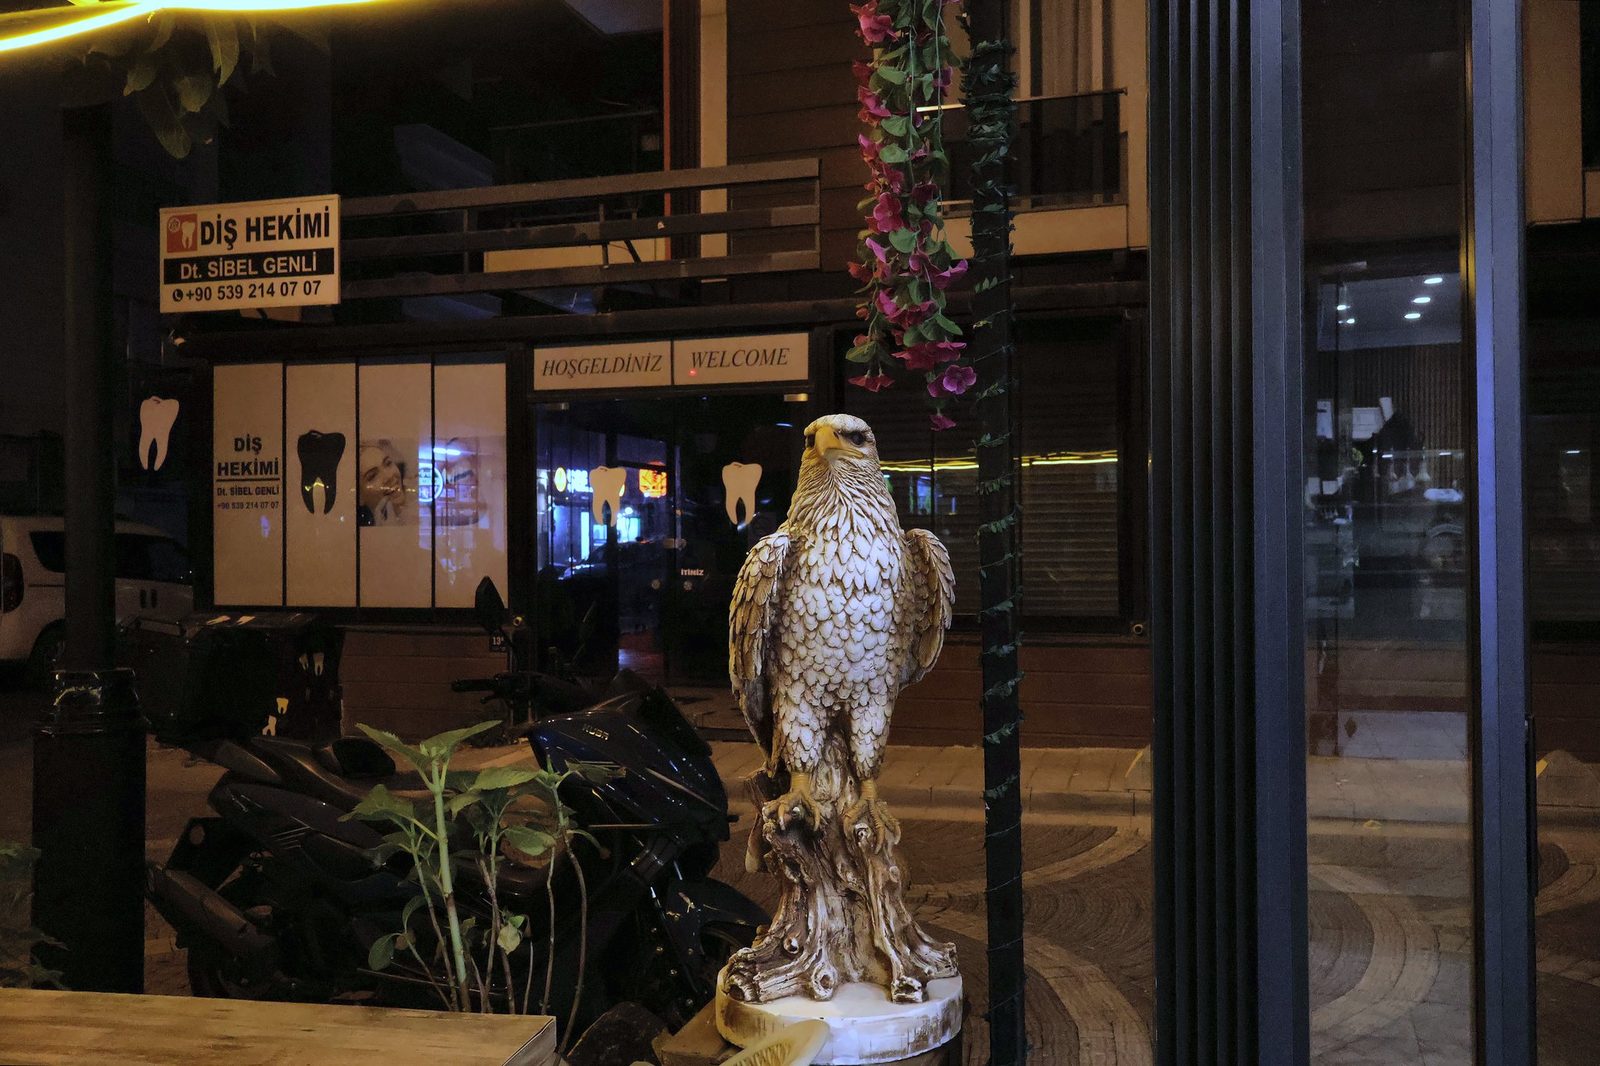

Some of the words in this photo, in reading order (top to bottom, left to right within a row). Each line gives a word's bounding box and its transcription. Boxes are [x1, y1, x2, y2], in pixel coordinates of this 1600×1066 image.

[200, 214, 237, 250] DİŞ
[245, 205, 330, 242] HEKİMİ
[180, 263, 202, 280] Dt.
[208, 257, 258, 277] SİBEL
[263, 251, 317, 274] GENLİ
[186, 286, 212, 301] +90
[217, 285, 243, 300] 539
[248, 284, 275, 298] 214
[280, 281, 298, 296] 07
[303, 280, 321, 295] 07
[542, 352, 663, 379] HOŞGELDİNİZ
[691, 347, 790, 369] WELCOME
[234, 433, 262, 455] DİŞ
[217, 457, 279, 476] HEKİMİ
[230, 484, 254, 496] SİBEL
[255, 484, 280, 496] GENLİ
